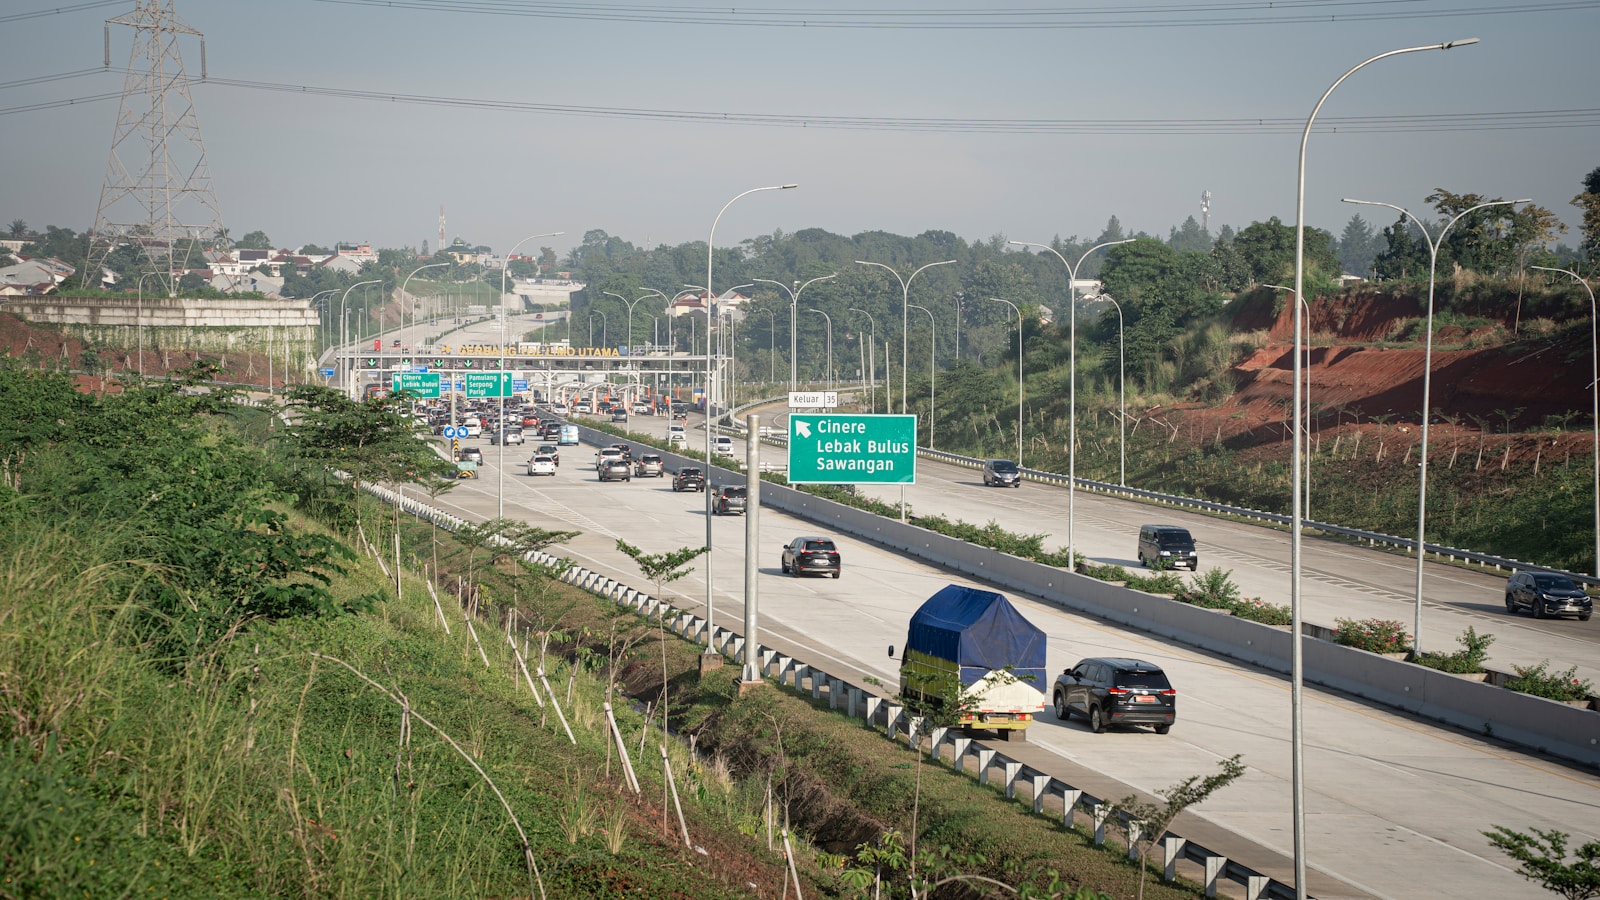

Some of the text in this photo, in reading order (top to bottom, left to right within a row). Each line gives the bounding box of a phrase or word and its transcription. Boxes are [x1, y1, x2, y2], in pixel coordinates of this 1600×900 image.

[545, 346, 576, 357] LIMO
[578, 347, 620, 357] UTAMA
[468, 374, 498, 382] Pamulang
[468, 381, 493, 389] Serpong
[468, 388, 486, 396] Parigi
[793, 394, 836, 404] Keluar 35
[817, 419, 866, 434] Cinere
[817, 438, 909, 454] Lebak Bulus
[816, 457, 894, 474] Sawangan
